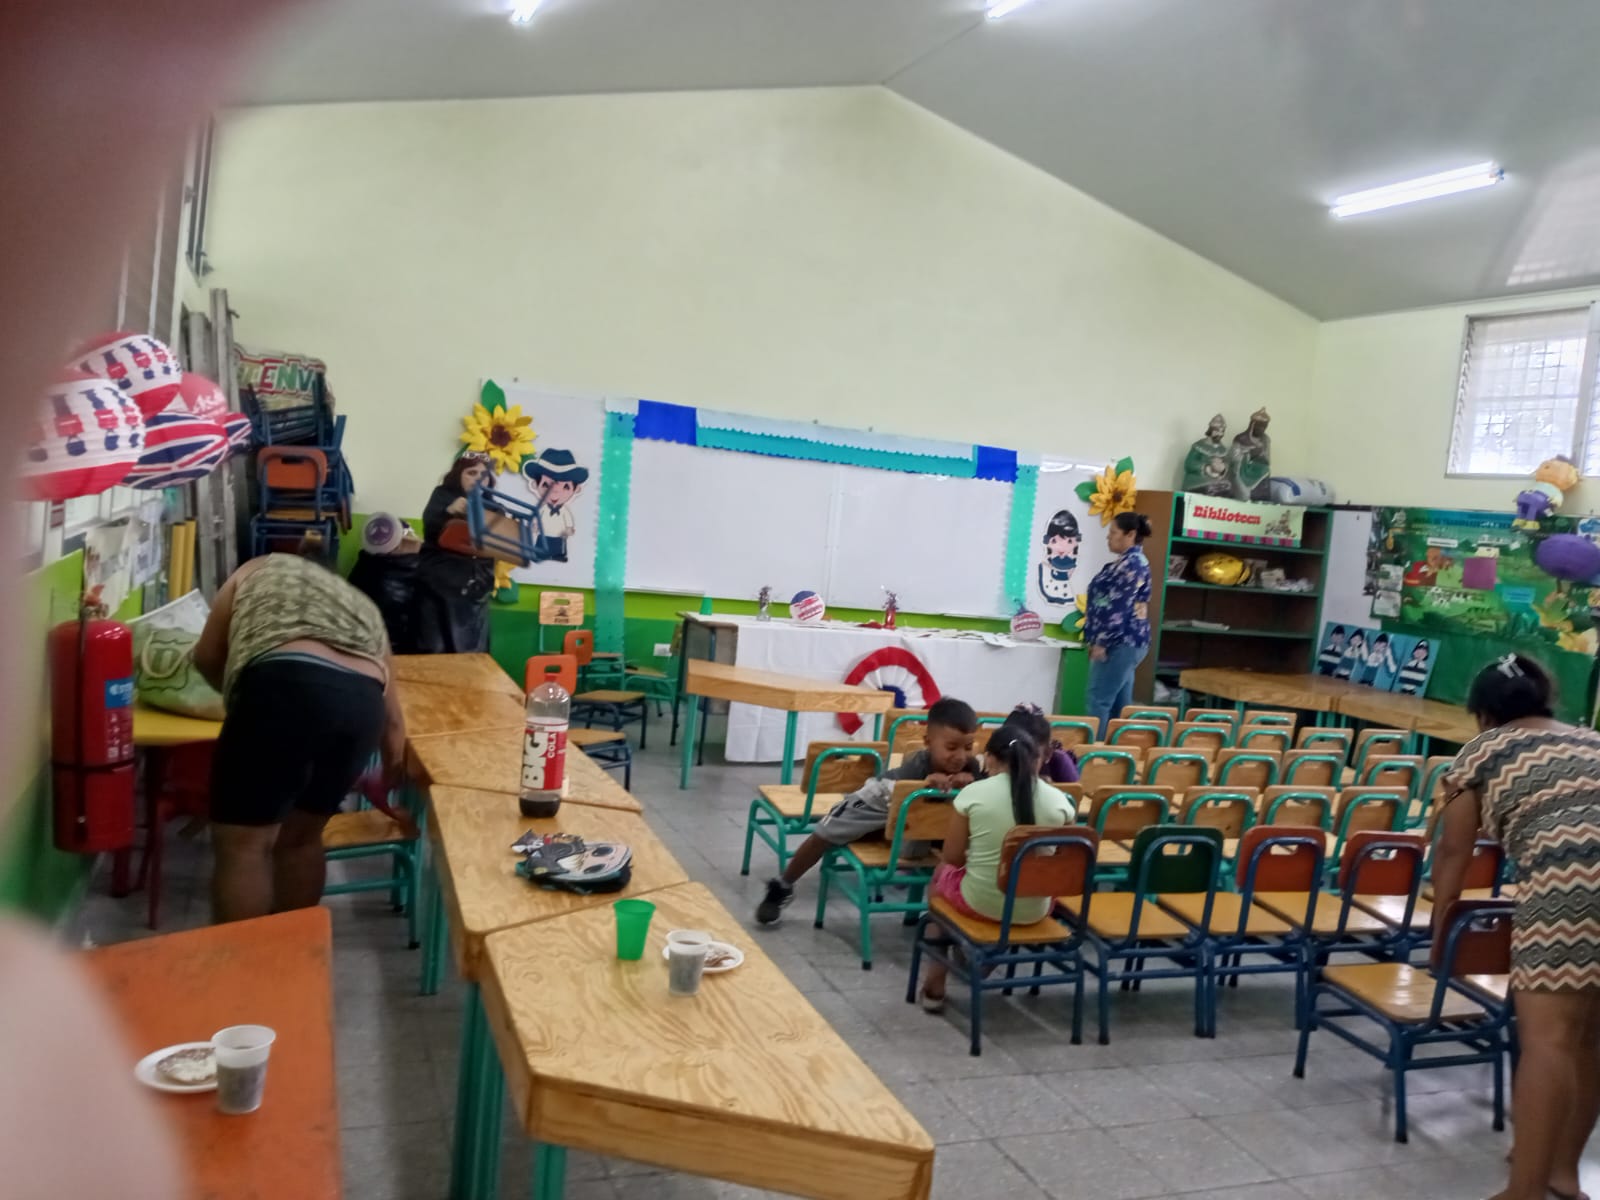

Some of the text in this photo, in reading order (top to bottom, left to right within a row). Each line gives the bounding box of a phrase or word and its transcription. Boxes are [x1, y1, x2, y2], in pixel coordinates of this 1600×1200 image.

[1193, 505, 1261, 525] Biblioteca
[547, 732, 557, 758] COLA
[521, 731, 549, 789] BIG
